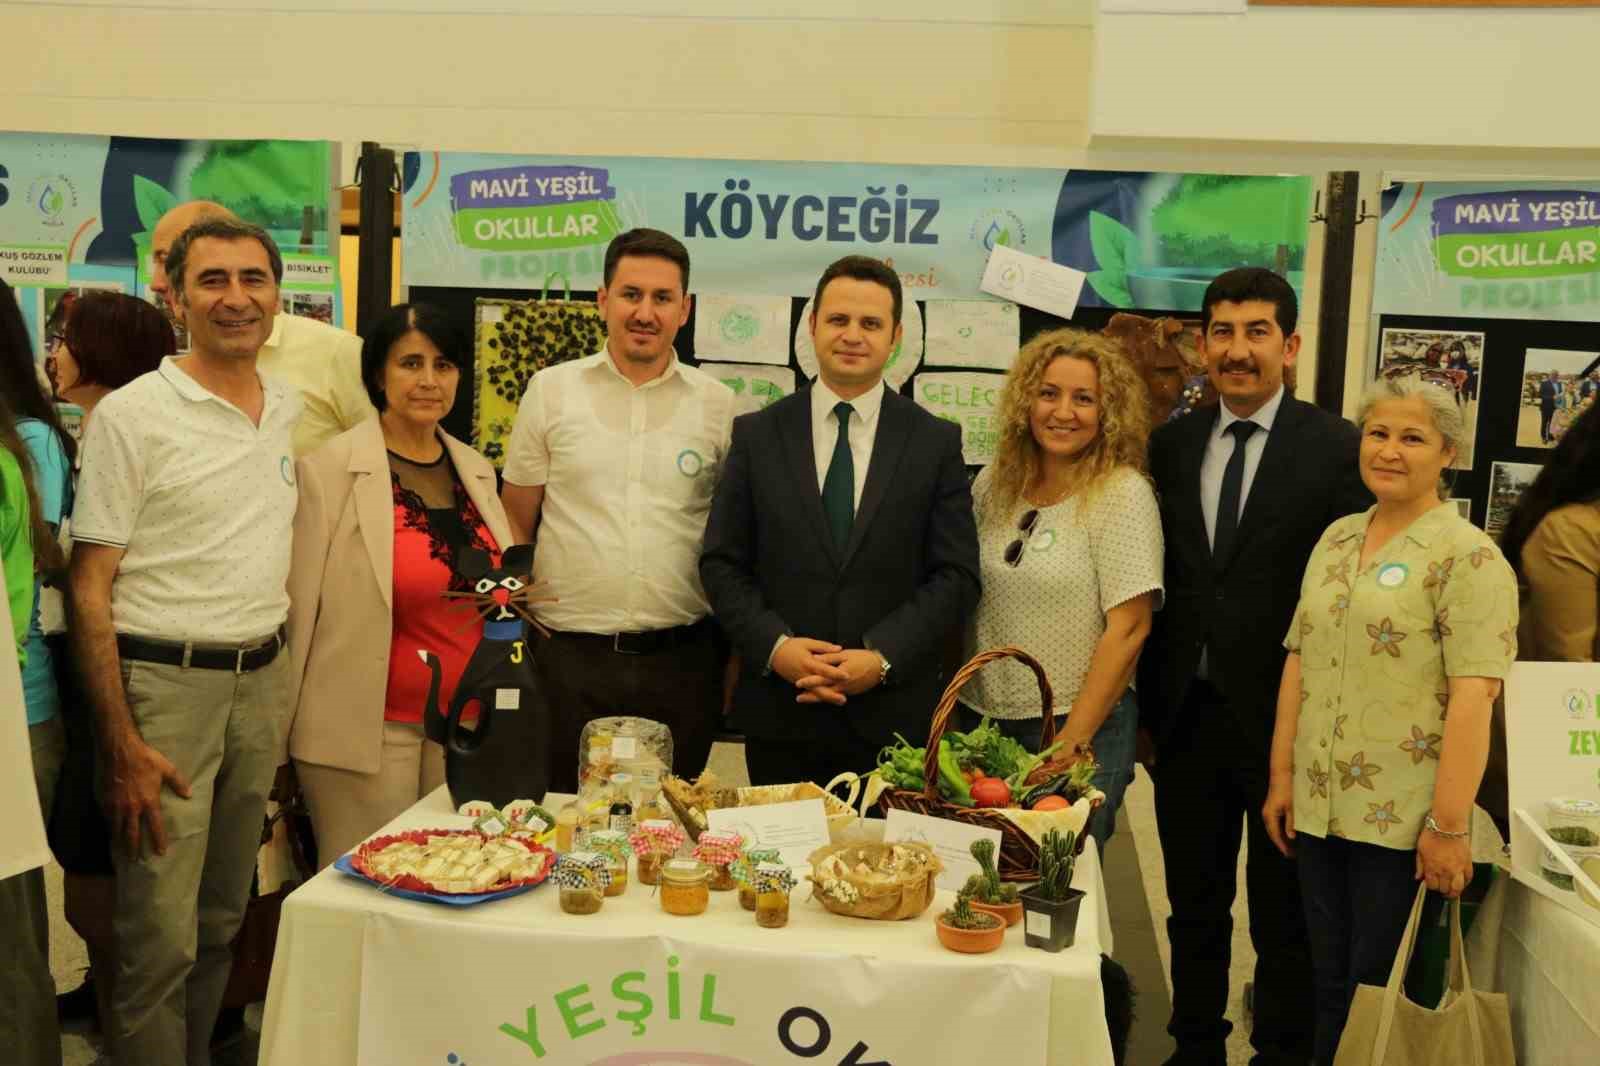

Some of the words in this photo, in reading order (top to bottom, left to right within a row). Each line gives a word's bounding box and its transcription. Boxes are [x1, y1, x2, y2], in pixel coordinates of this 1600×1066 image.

[470, 173, 528, 199] MAVİ
[535, 174, 601, 200] YEŞİL
[683, 178, 940, 245] KÖYCEĞİZ
[1455, 198, 1520, 224] MAVİ
[1528, 196, 1600, 226] YEŞİL
[475, 214, 599, 241] OKULLAR
[1456, 240, 1597, 268] OKULLAR
[510, 641, 524, 664] J
[498, 955, 735, 1059] YEŞİL
